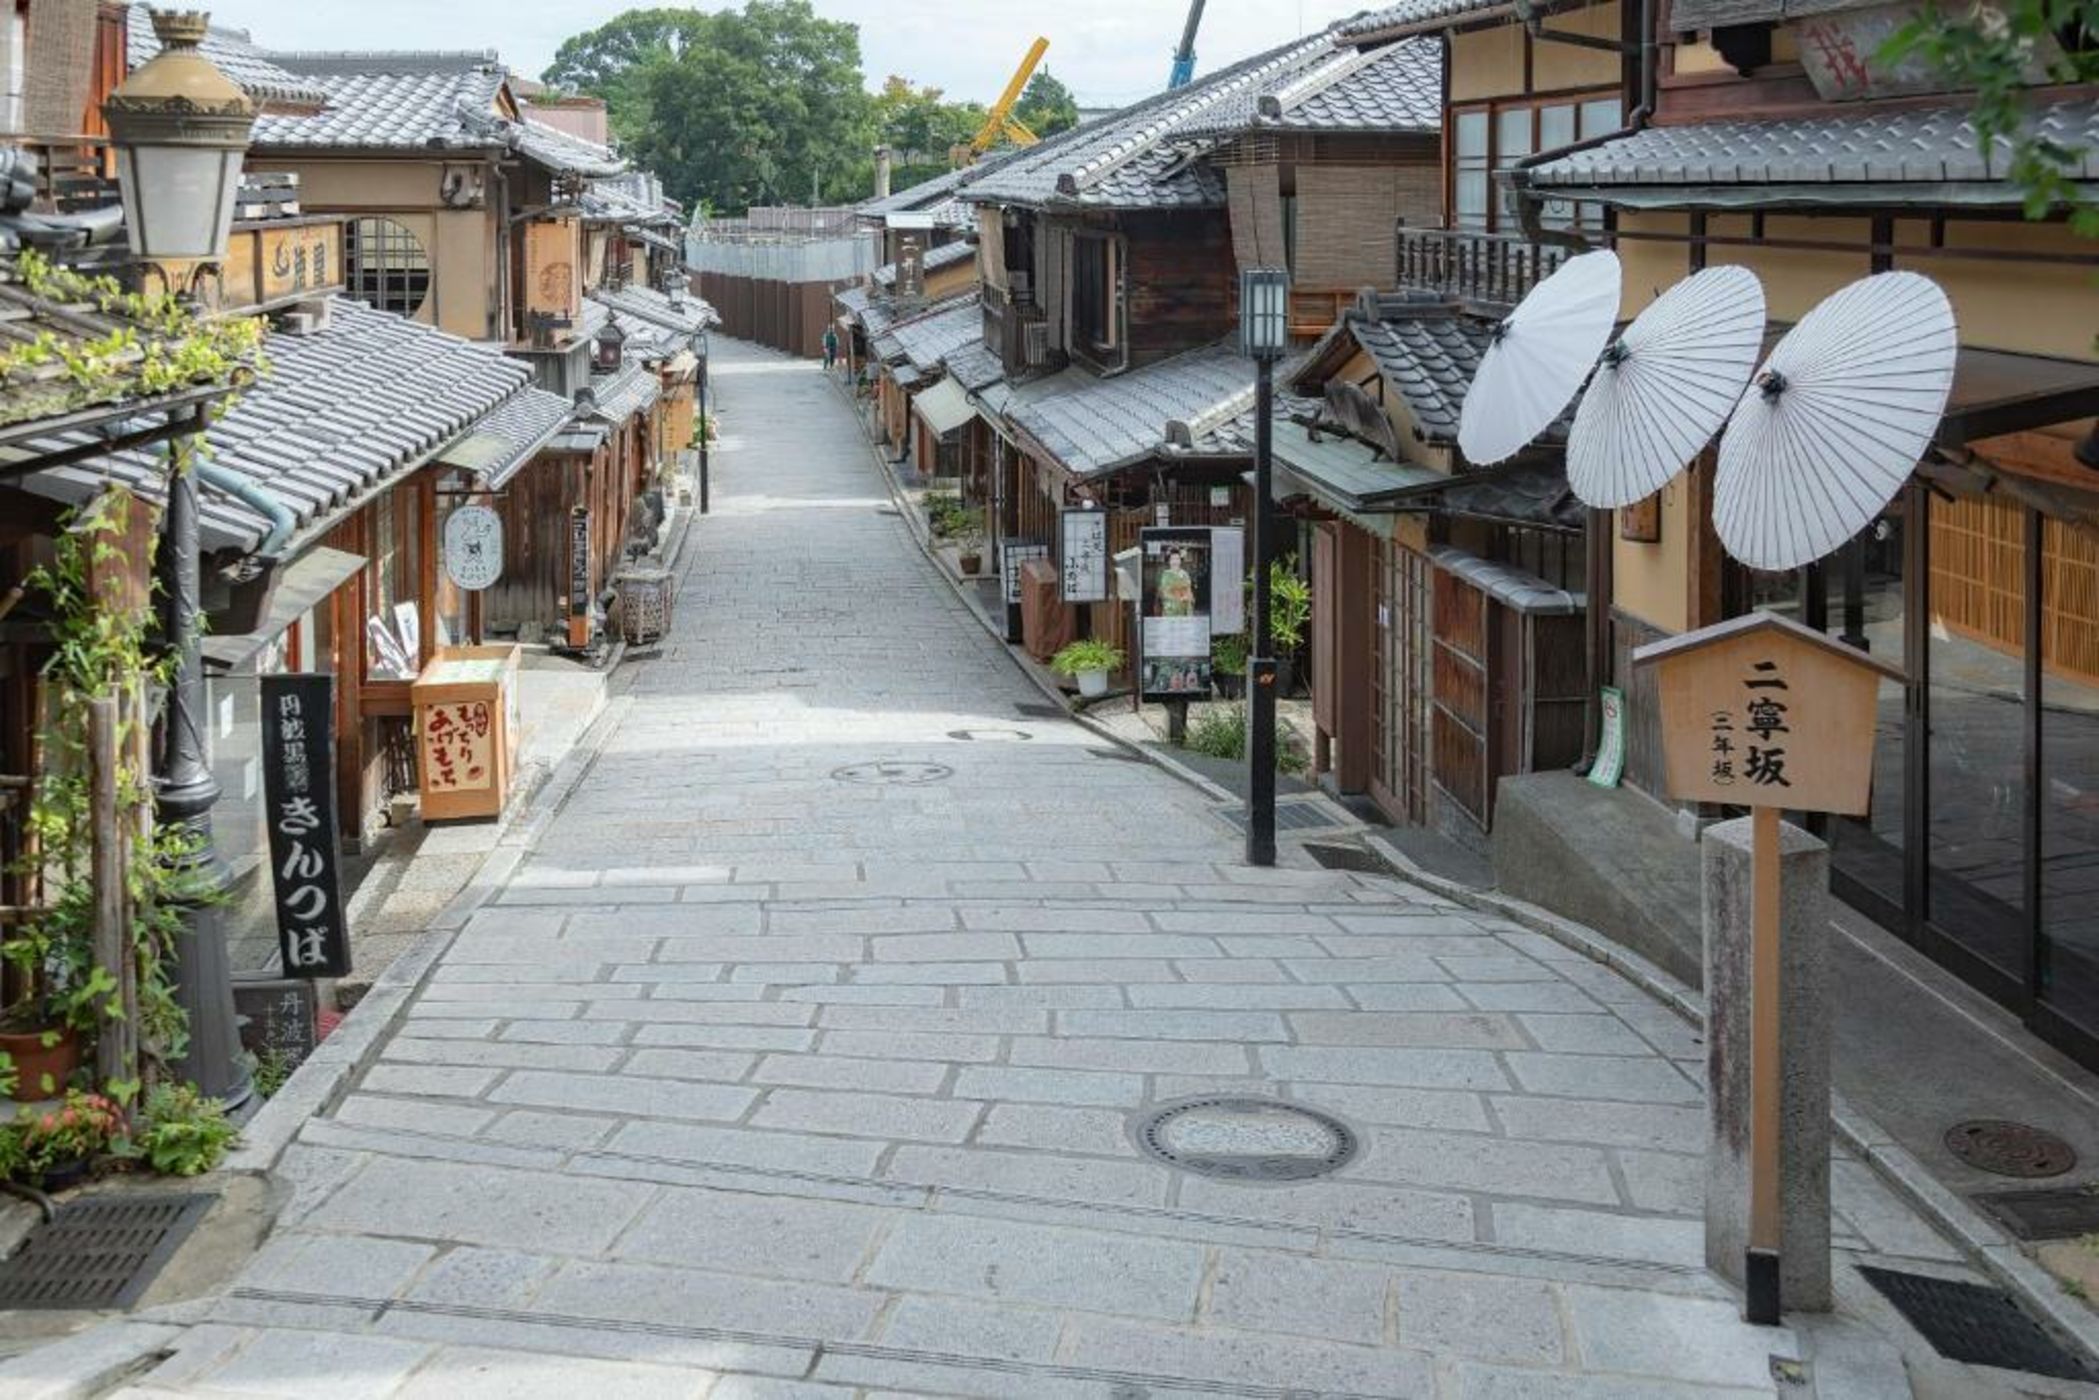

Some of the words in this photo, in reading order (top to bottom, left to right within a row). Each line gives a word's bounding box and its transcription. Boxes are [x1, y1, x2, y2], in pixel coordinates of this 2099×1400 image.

[430, 709, 460, 786] あげもち
[457, 705, 474, 763] もっちり
[1743, 661, 1791, 787] 二寧坂
